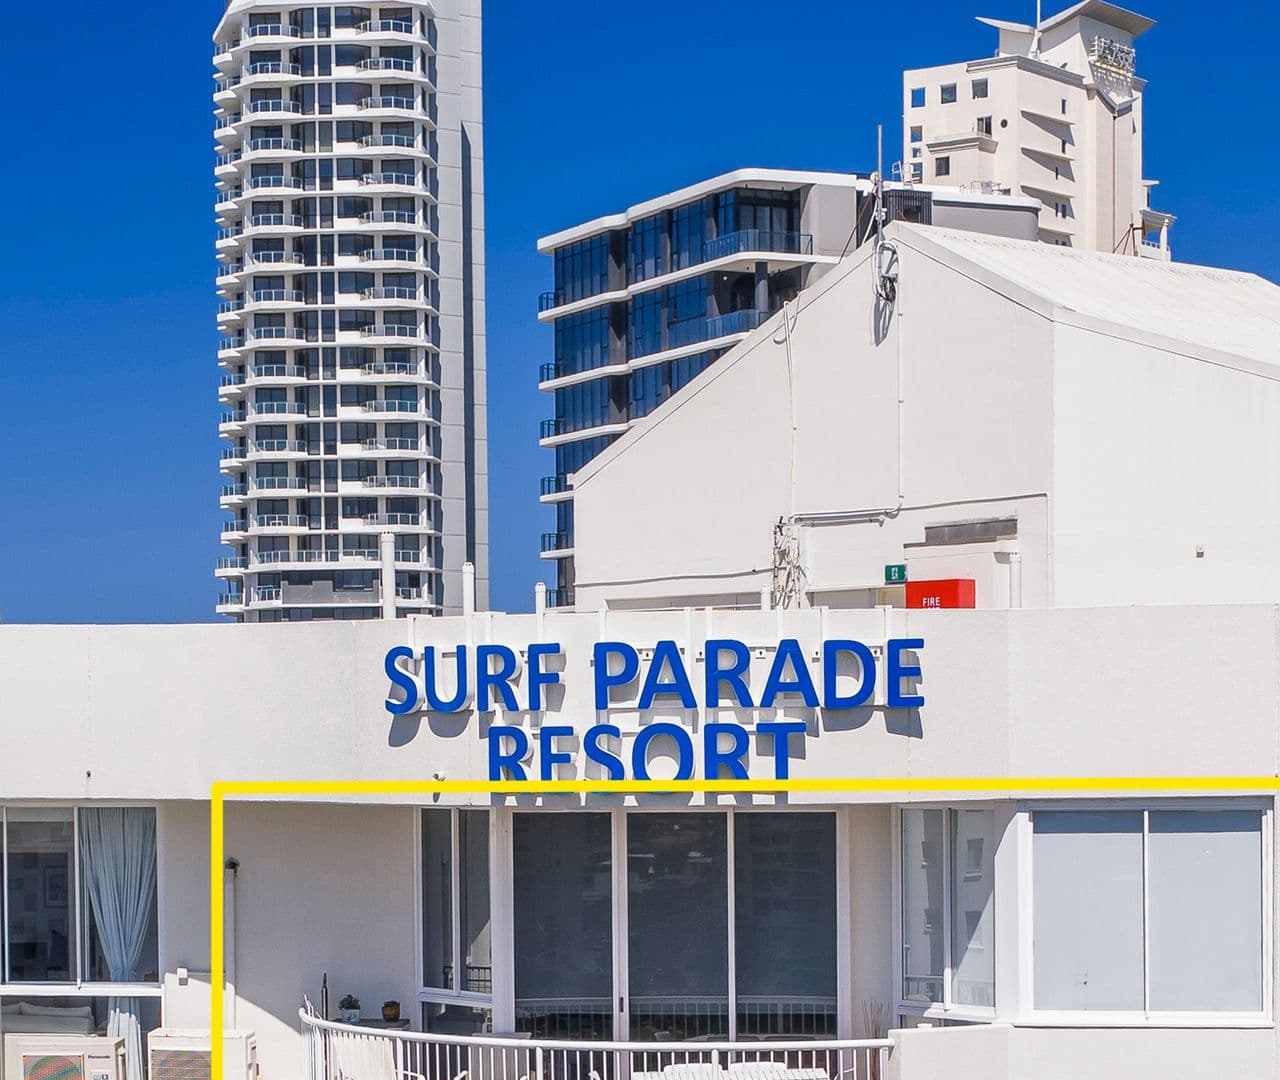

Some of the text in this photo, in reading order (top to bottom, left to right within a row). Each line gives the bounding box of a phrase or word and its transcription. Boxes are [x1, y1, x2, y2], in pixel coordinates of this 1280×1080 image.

[922, 597, 940, 606] FIRE
[384, 638, 925, 715] SURF PARADE
[488, 721, 807, 793] RESORT
